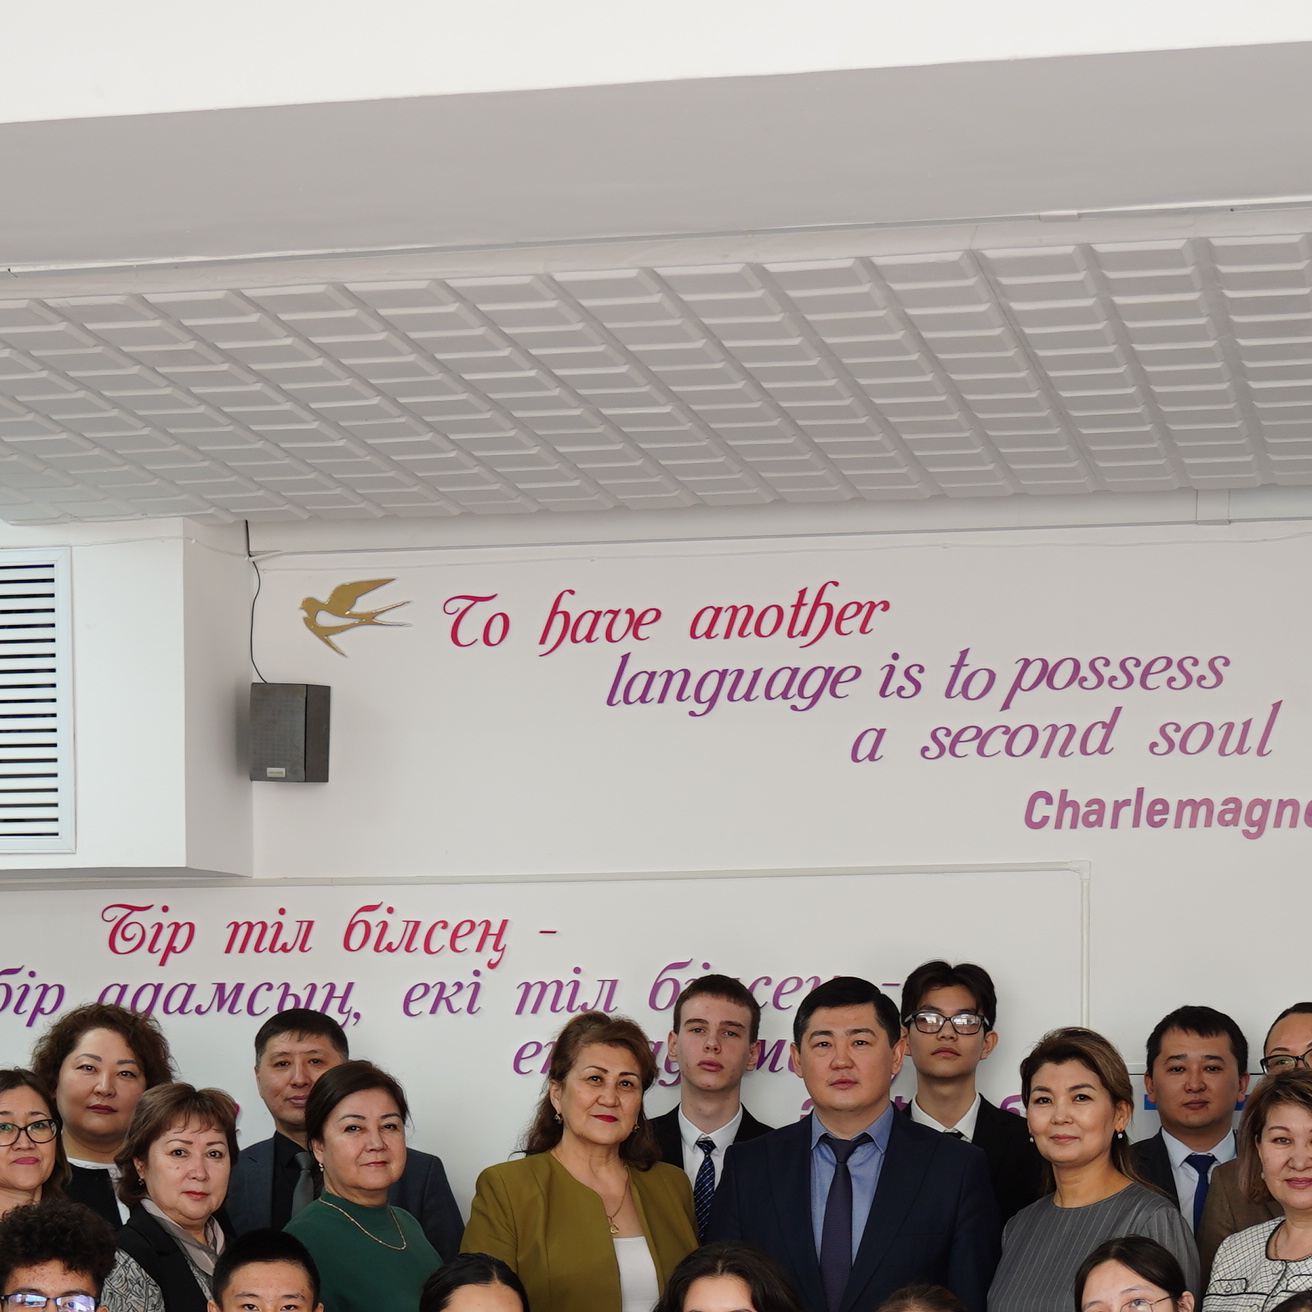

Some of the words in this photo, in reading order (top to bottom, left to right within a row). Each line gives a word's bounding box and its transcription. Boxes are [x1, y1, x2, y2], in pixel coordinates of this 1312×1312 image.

[441, 593, 511, 648] To
[537, 589, 662, 657] have
[689, 580, 892, 649] another
[605, 651, 863, 718] language
[879, 652, 925, 700] is
[944, 648, 996, 702] to
[999, 648, 1231, 712] possess
[850, 726, 887, 763] a
[920, 706, 1123, 761] second
[1148, 700, 1283, 758] soul
[100, 903, 196, 967] Бір
[223, 907, 316, 955] тіл
[342, 901, 510, 970] білсең
[402, 969, 482, 1018] екі
[514, 966, 620, 1016] тіл
